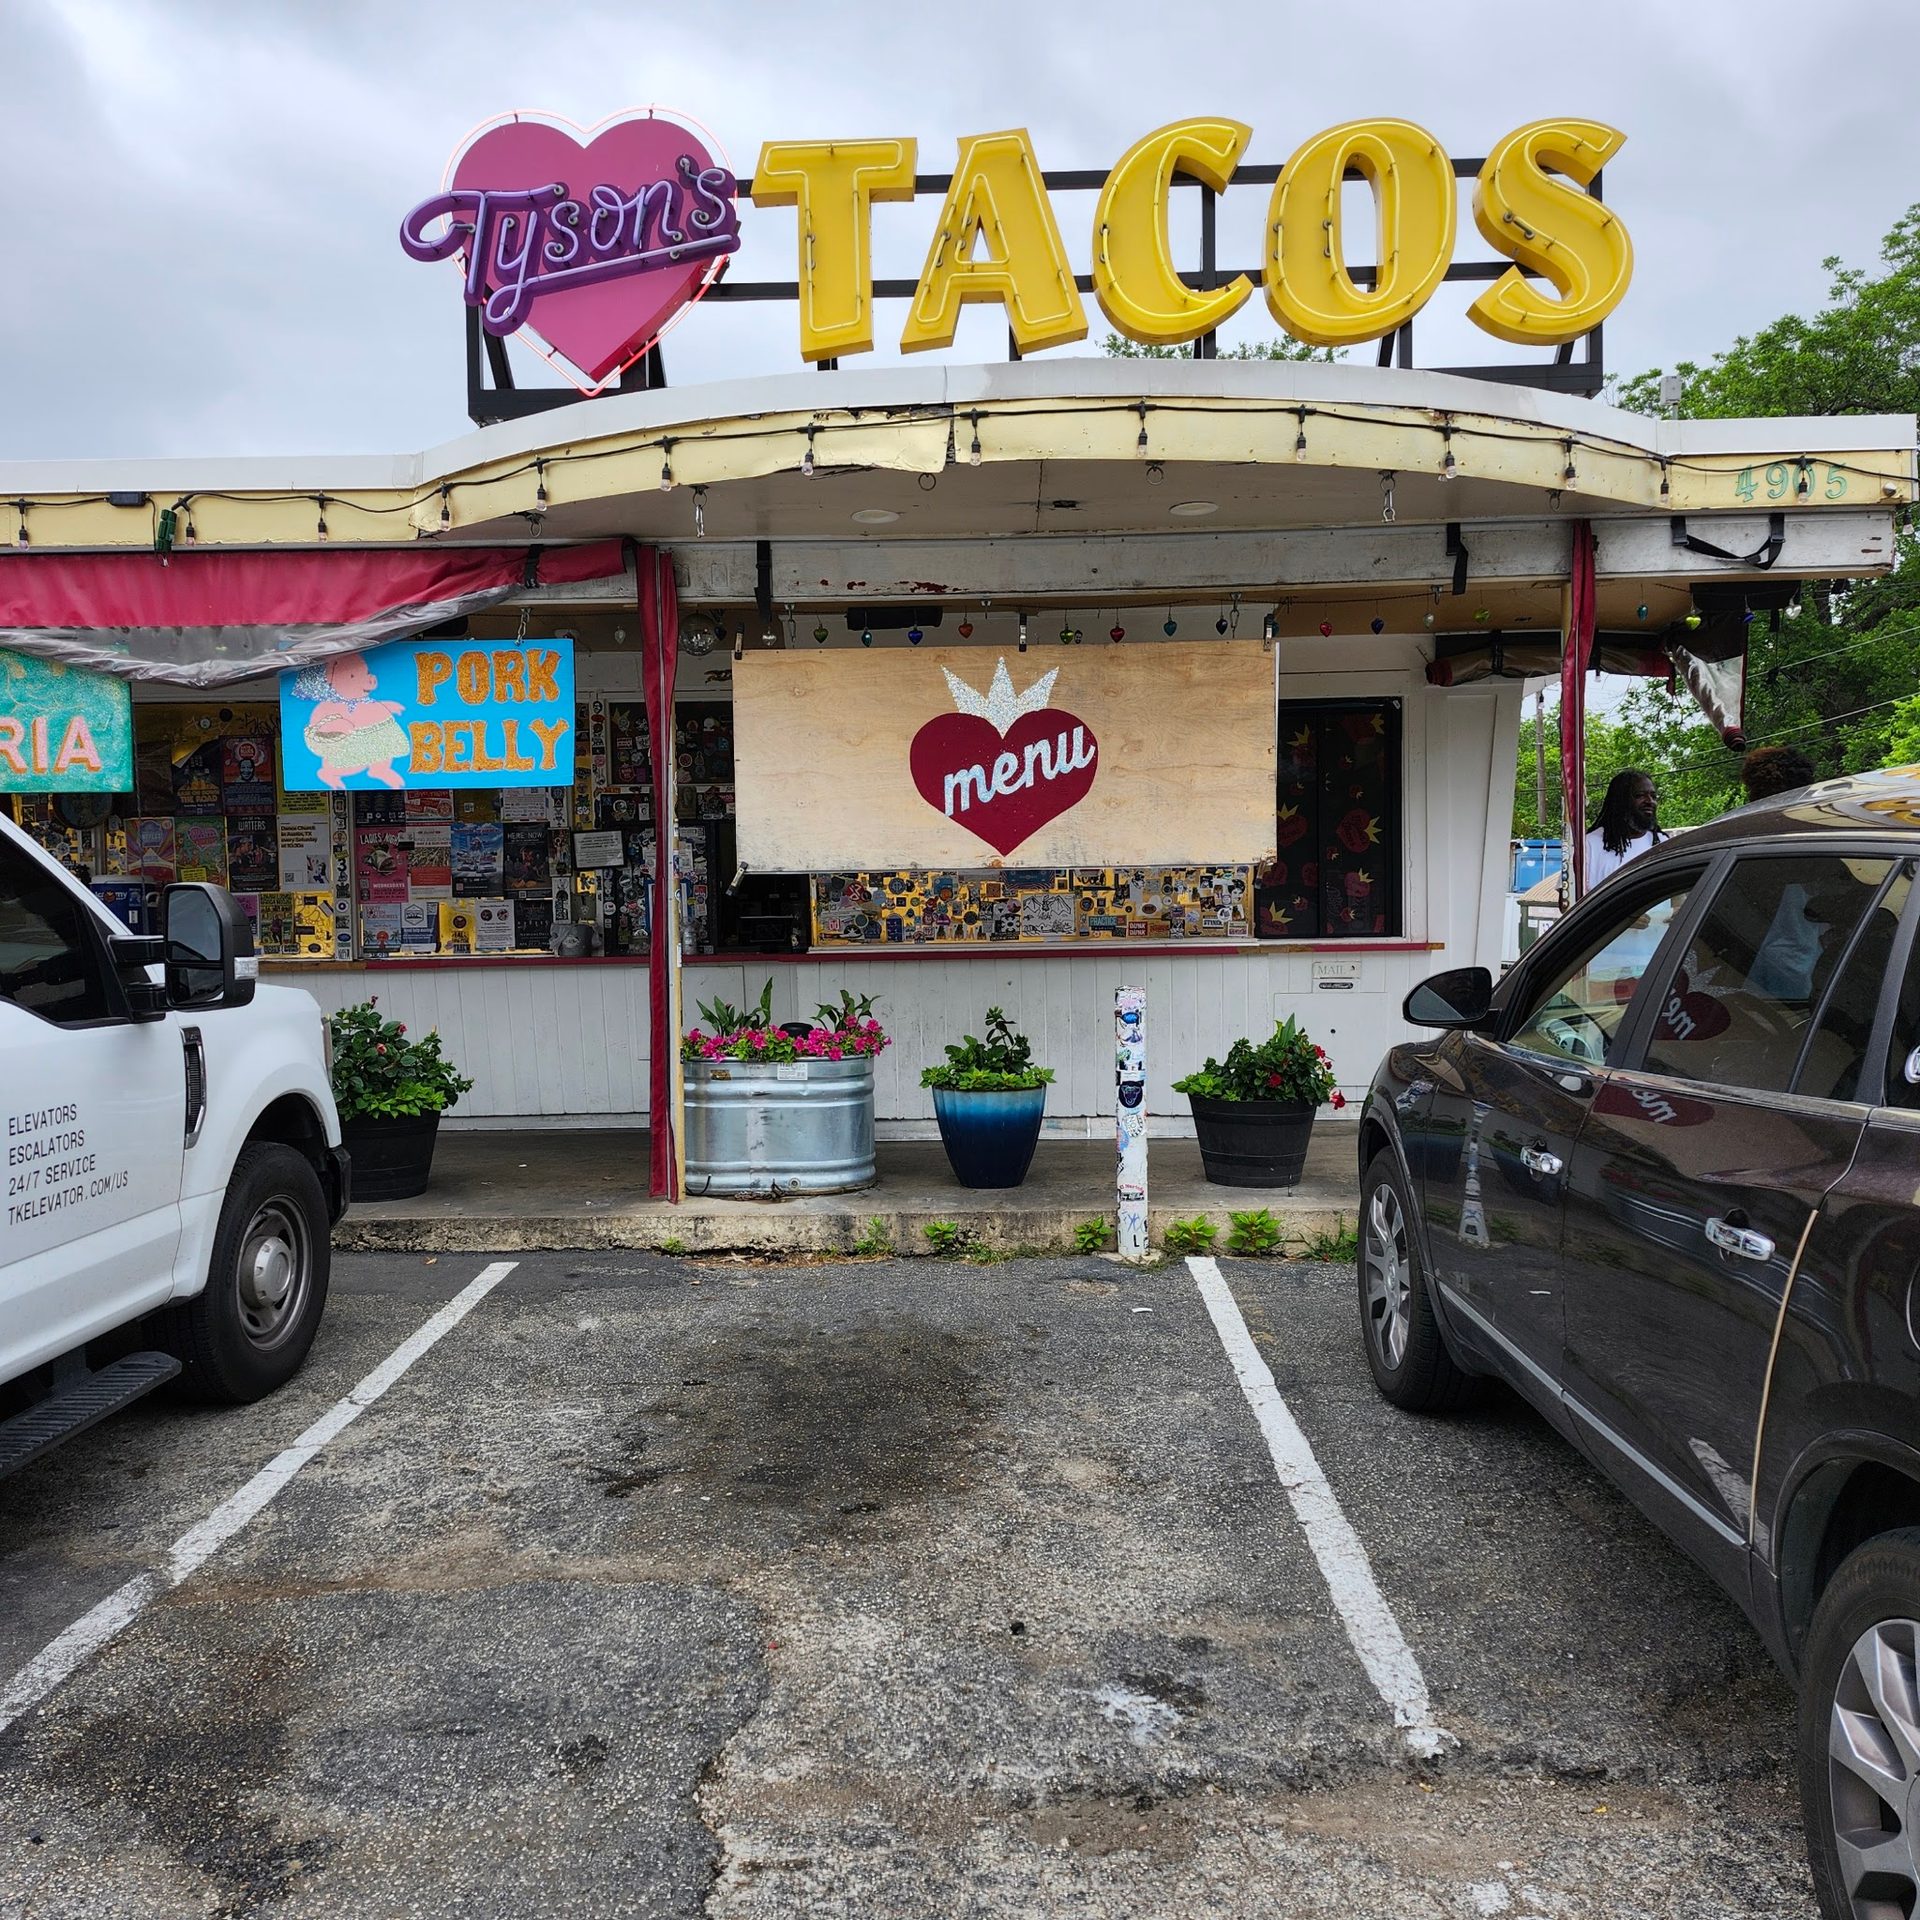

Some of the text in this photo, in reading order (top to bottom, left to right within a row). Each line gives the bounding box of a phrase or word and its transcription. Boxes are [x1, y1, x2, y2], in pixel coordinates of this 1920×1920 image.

[400, 153, 741, 336] Tyson's
[751, 117, 1634, 362] TACOS
[1735, 462, 1847, 503] 4905
[413, 648, 562, 706] PORK
[407, 716, 571, 775] BELLY
[943, 725, 1096, 818] menu
[1318, 965, 1346, 975] MAIL
[8, 1103, 77, 1136] ELEVATORS
[9, 1129, 85, 1166] ESCALATORS
[8, 1154, 96, 1196] 24/7 SERVICE
[8, 1170, 128, 1226] TKELEVATOR.COM/US
